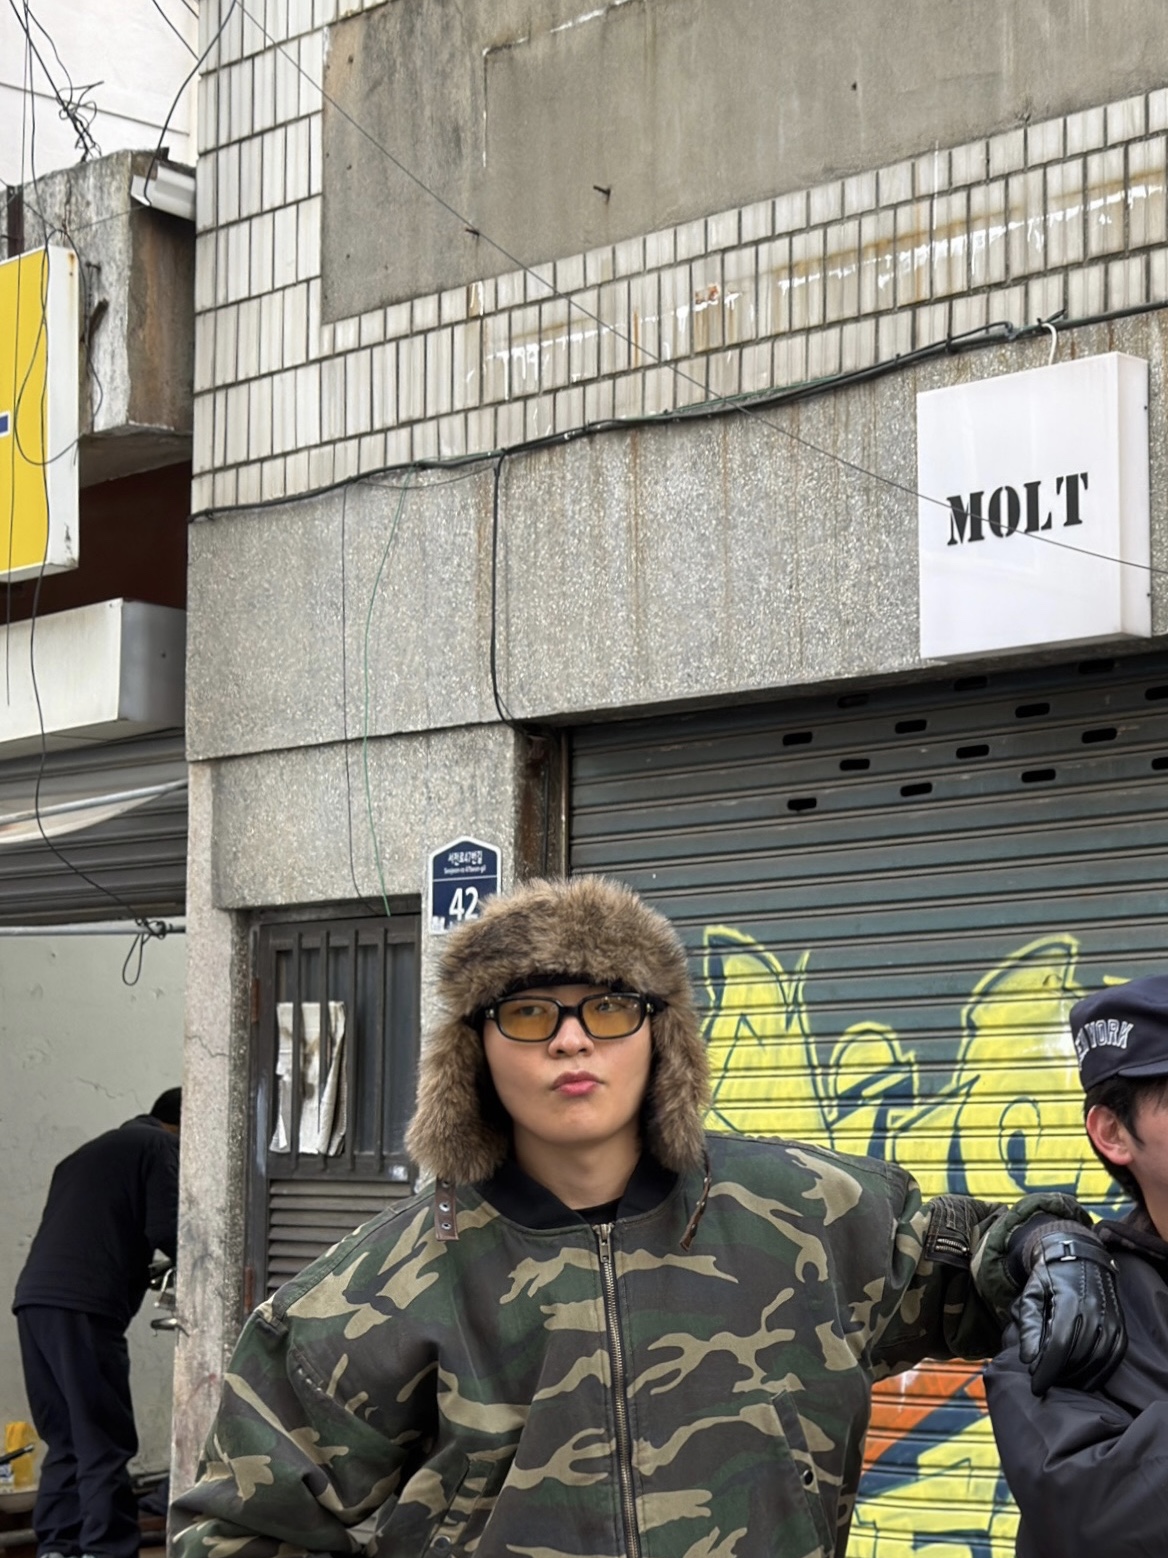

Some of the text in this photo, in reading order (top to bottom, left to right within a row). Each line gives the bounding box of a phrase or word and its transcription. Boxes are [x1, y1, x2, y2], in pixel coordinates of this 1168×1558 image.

[946, 472, 1089, 546] MOLT
[448, 886, 479, 921] 42
[1084, 1018, 1134, 1049] YORK
